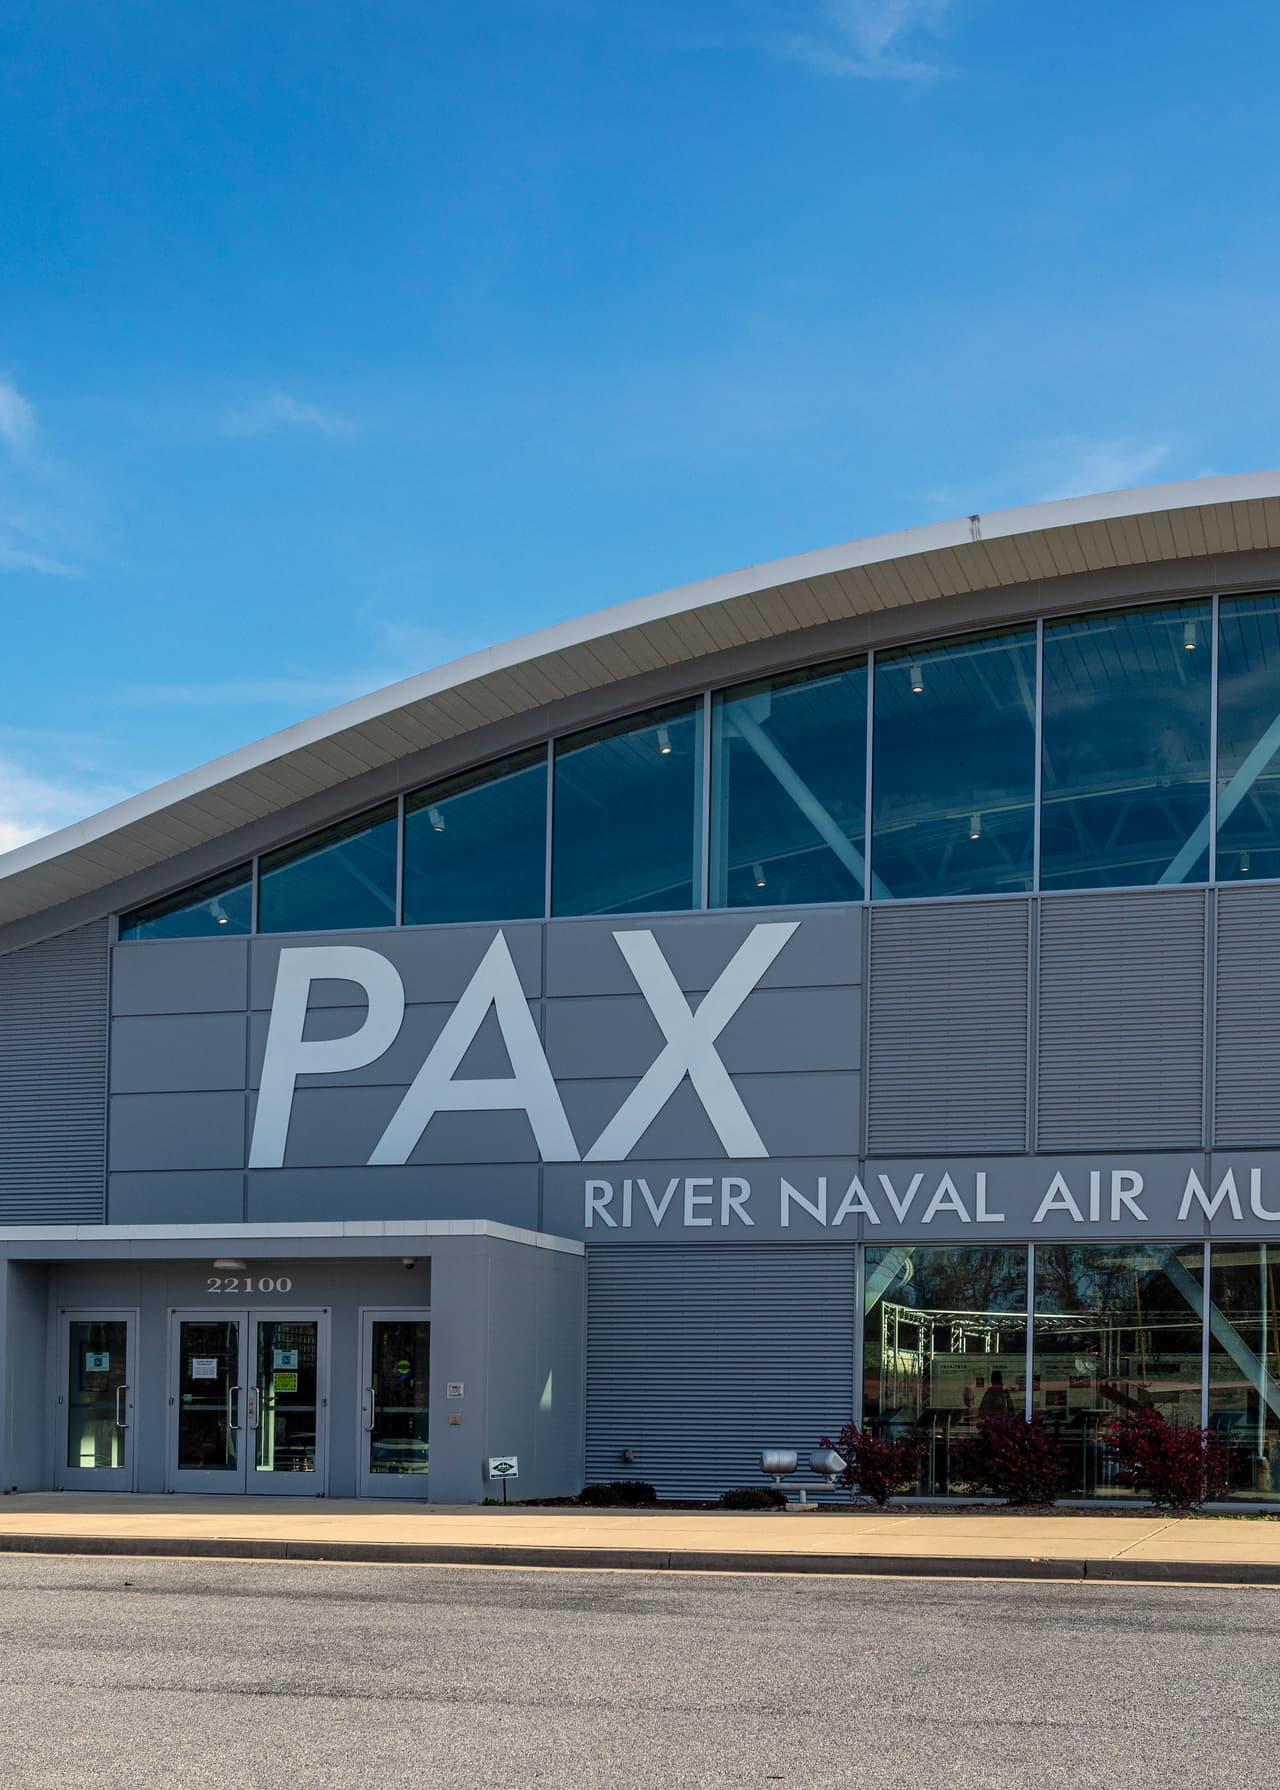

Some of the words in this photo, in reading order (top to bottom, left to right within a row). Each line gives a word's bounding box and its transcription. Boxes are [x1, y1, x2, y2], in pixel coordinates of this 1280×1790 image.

[249, 922, 800, 1168] PAX
[584, 1177, 755, 1228] RIVER
[780, 1171, 1005, 1227] NAVAL
[1032, 1169, 1149, 1223] AIR
[207, 1277, 292, 1293] 22100
